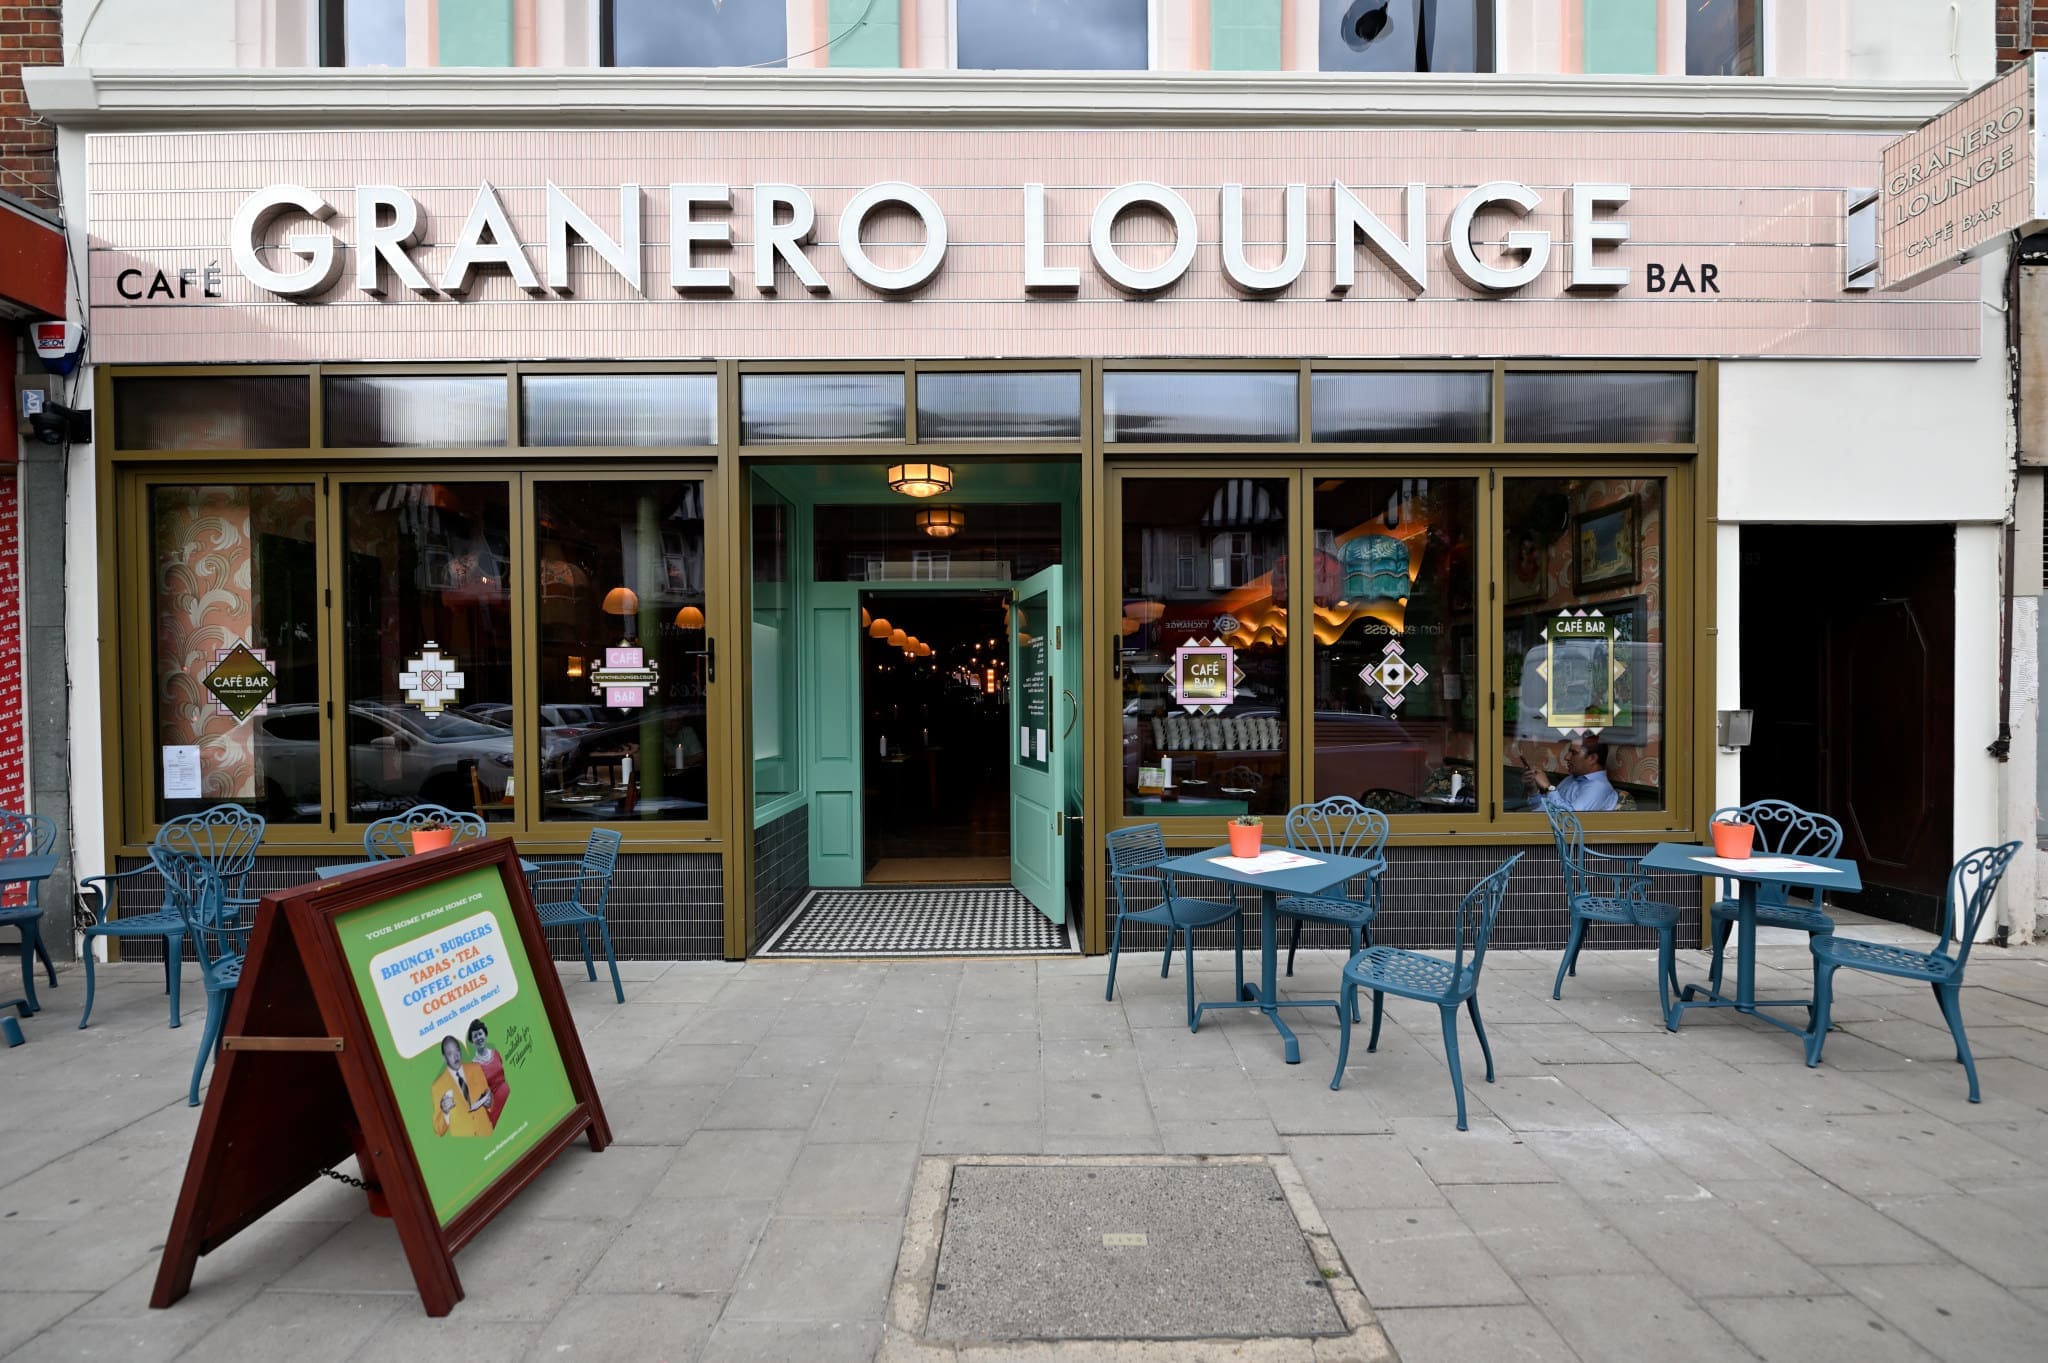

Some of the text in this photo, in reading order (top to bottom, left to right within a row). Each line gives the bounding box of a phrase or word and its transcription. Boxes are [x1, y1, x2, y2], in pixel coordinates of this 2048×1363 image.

[1888, 106, 2024, 197] GRANERO
[1896, 144, 2014, 226] LOUNGE
[230, 178, 1632, 300] GRANERO LOUNGE
[1906, 201, 2001, 257] CAFÉ BAR
[117, 260, 221, 300] CAFÉ
[1646, 263, 1721, 293] BAR
[1555, 618, 1606, 633] CAFÉ BAR
[213, 674, 269, 687] CAFÉ BAR
[1191, 660, 1220, 676] CAFÉ
[1194, 677, 1216, 689] BAR
[613, 691, 636, 702] BAR
[365, 892, 483, 940] YOUR HOME FROM HOME FOR
[381, 923, 493, 980] BRUNCH BURGERS
[410, 945, 480, 984] TAPAS TEA
[403, 954, 495, 1007] COFFEE CAKES
[422, 974, 489, 1015] COCKTAILS
[419, 985, 501, 1036] and much much more!
